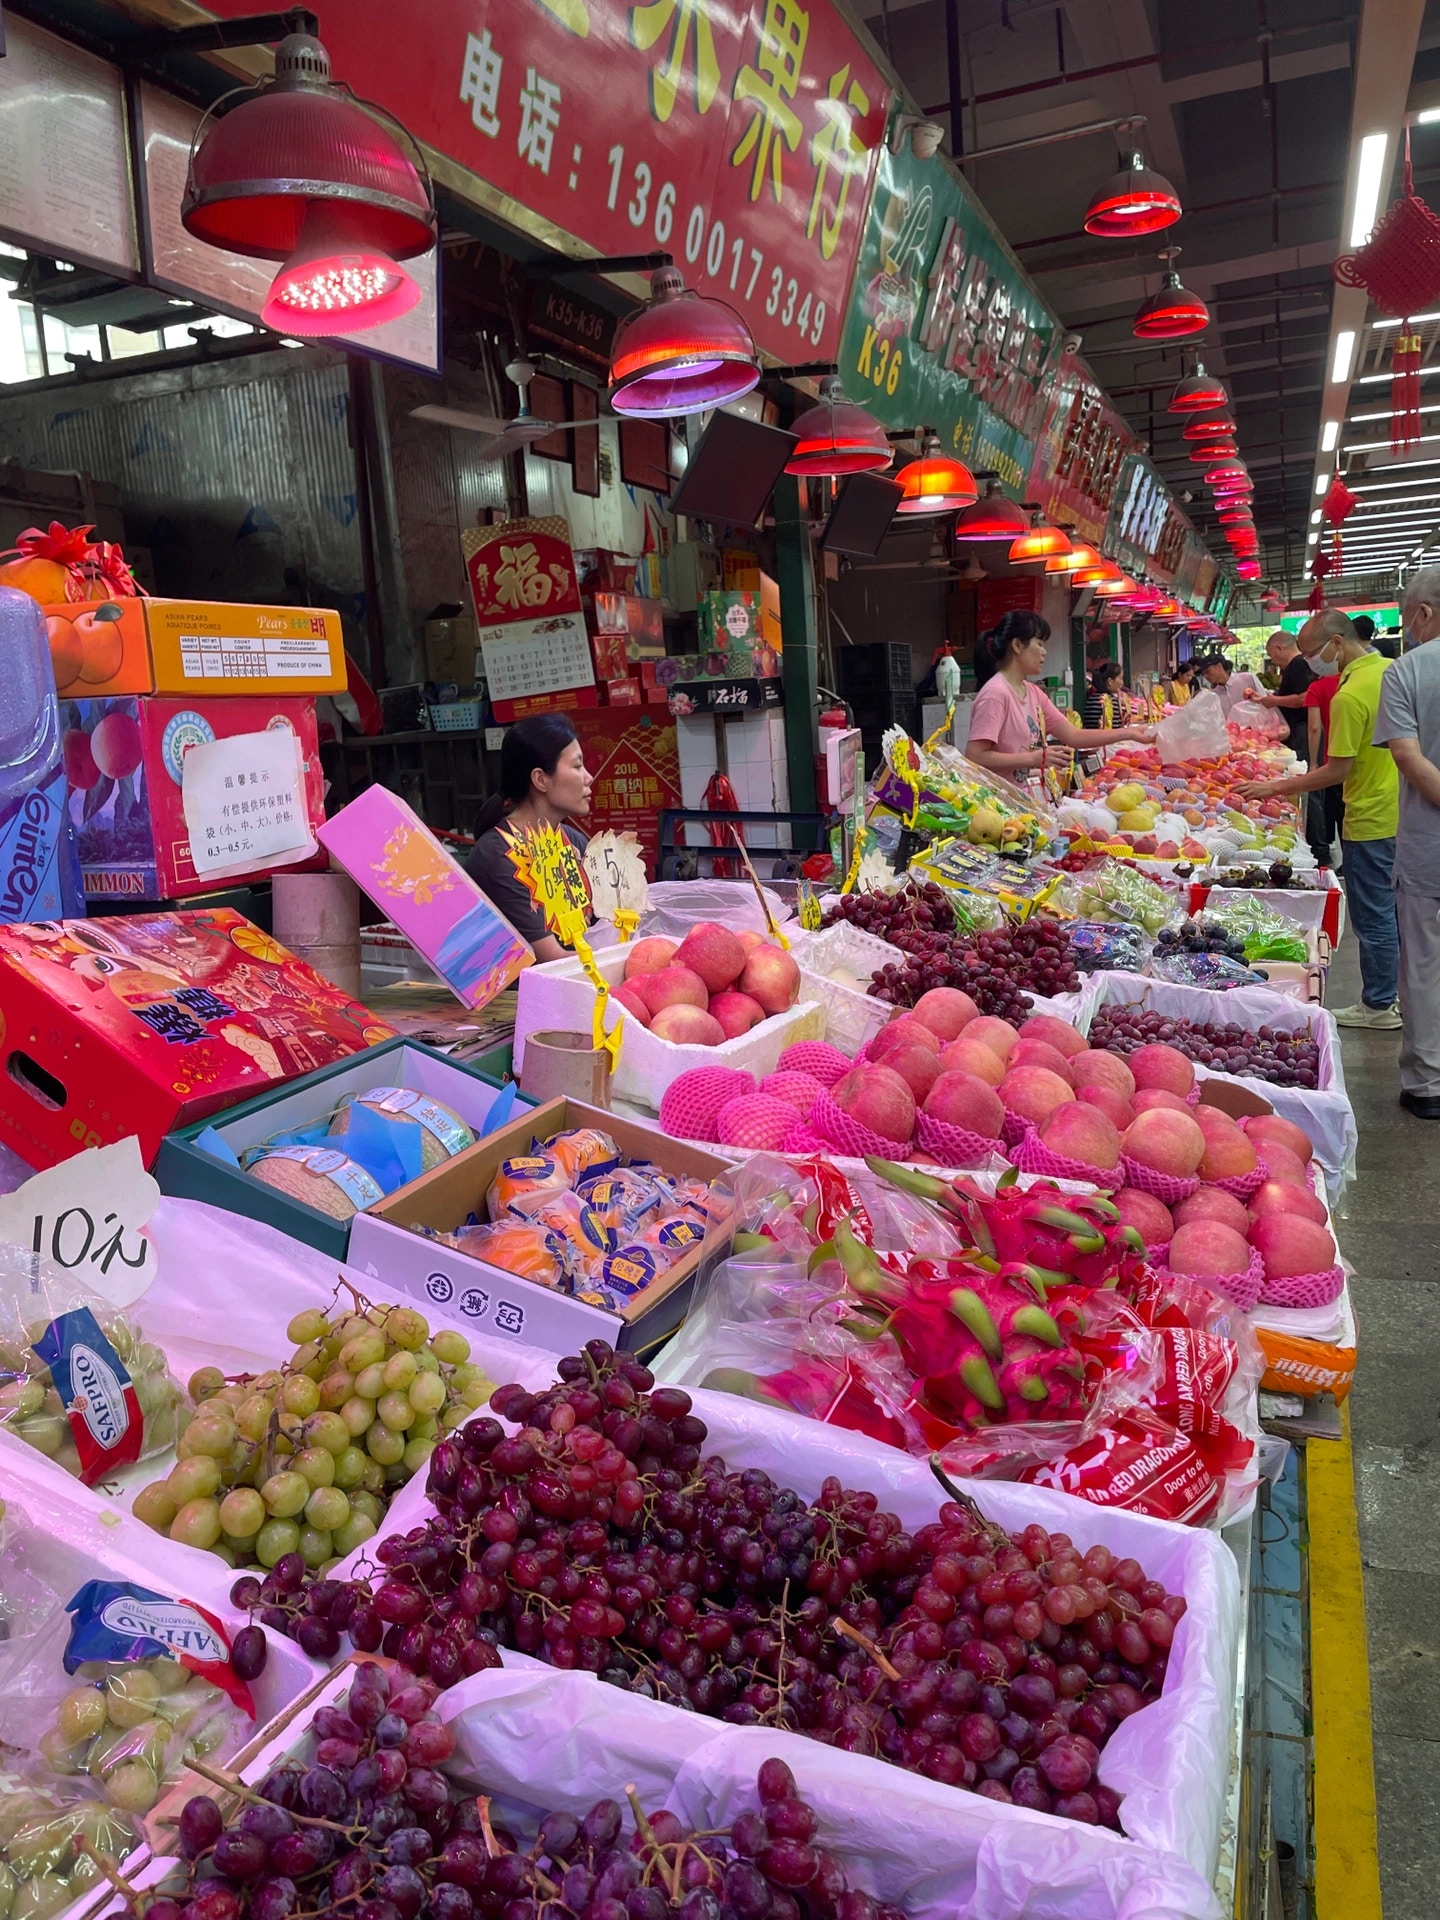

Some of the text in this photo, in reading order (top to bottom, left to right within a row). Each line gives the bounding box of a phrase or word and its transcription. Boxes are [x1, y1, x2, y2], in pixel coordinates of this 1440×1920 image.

[537, 0, 870, 260] 水果行
[855, 326, 903, 397] K36
[493, 542, 552, 610] 福
[165, 613, 208, 622] ASIAN PEARS
[256, 615, 288, 630] Pears
[716, 686, 749, 705] 石榴
[224, 770, 269, 789] 温馨提示
[614, 763, 639, 775] 2018
[598, 777, 658, 794] 新春纳福
[222, 792, 293, 818] 有偿提供环保塑料
[84, 871, 145, 894] IMMON
[31, 1208, 148, 1275] 10元
[76, 1356, 117, 1441] SAFPRO
[1108, 1473, 1134, 1497] RED
[1178, 1403, 1195, 1433] LONG
[1164, 1474, 1187, 1495] Door
[1186, 1467, 1197, 1479] to
[122, 1602, 135, 1612] LTD
[117, 1616, 222, 1656] SAFPRO
